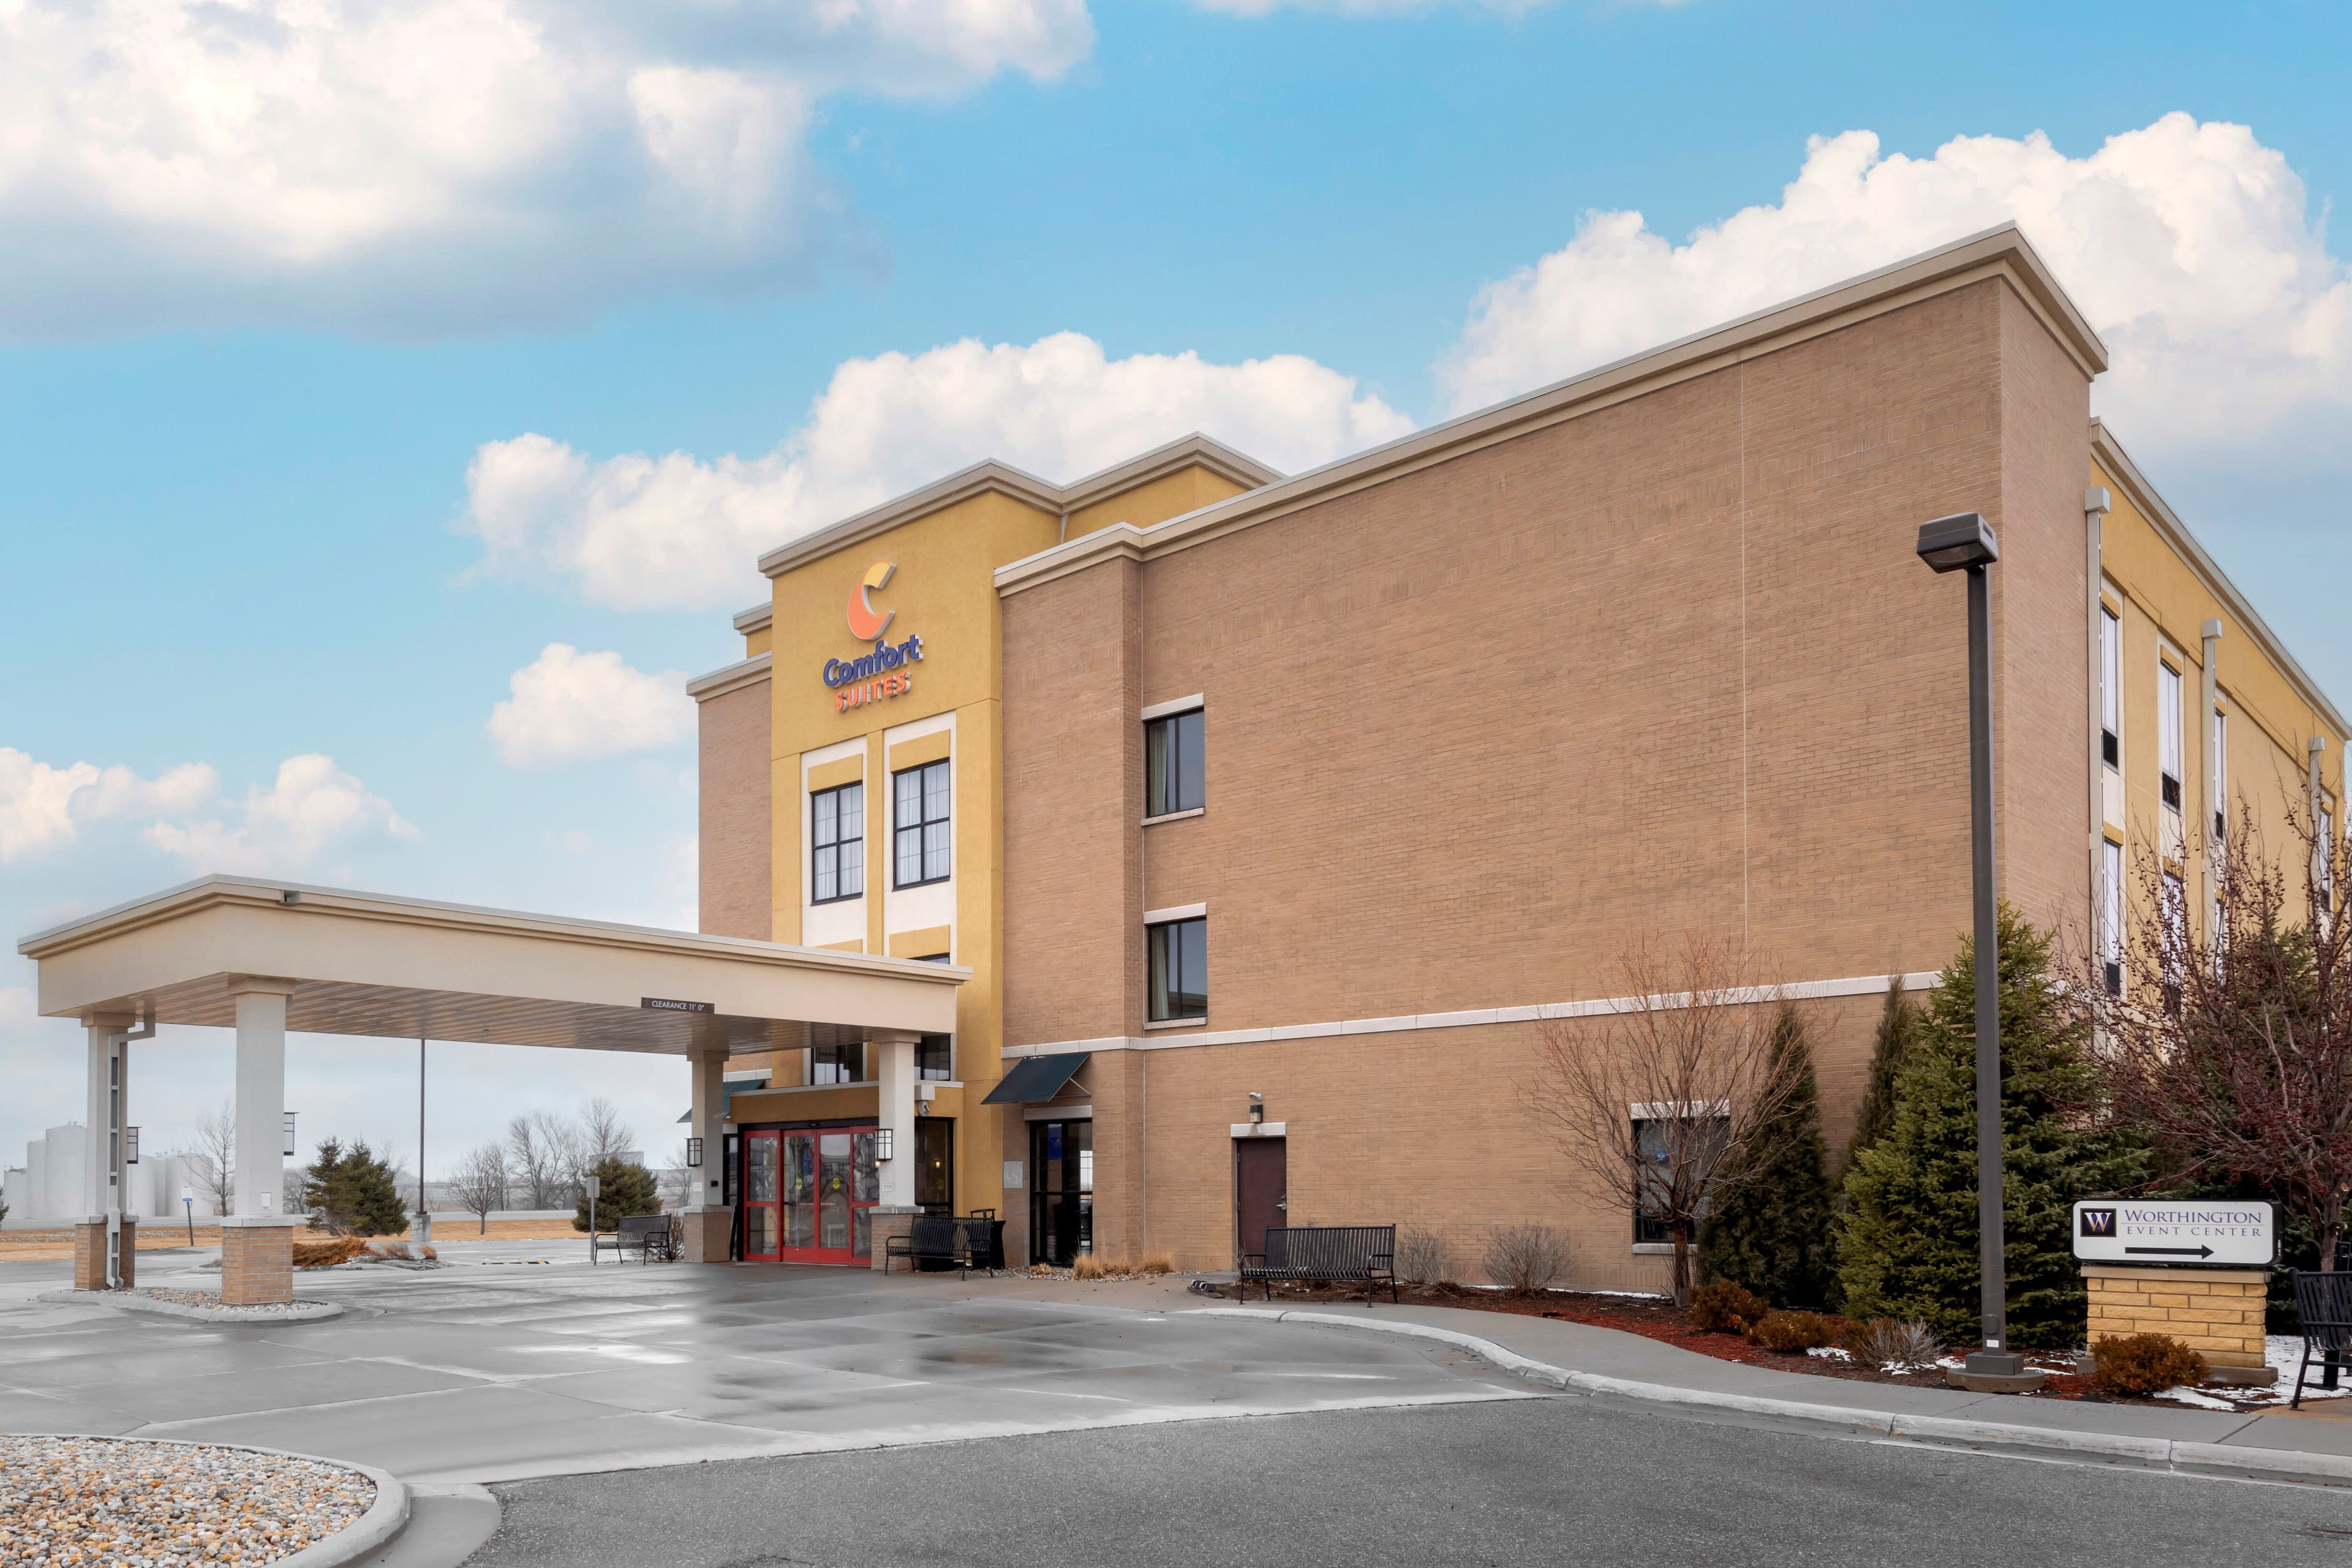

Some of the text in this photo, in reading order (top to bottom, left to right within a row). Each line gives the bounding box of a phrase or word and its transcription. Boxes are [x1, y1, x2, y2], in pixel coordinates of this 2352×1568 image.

[823, 634, 924, 688] Comfort
[834, 671, 911, 712] SUITES
[652, 1000, 687, 1009] CLEARANCE
[2084, 1212, 2112, 1233] W
[2125, 1210, 2261, 1223] WORTHINGTON
[2127, 1226, 2261, 1237] EVENT CENTER
